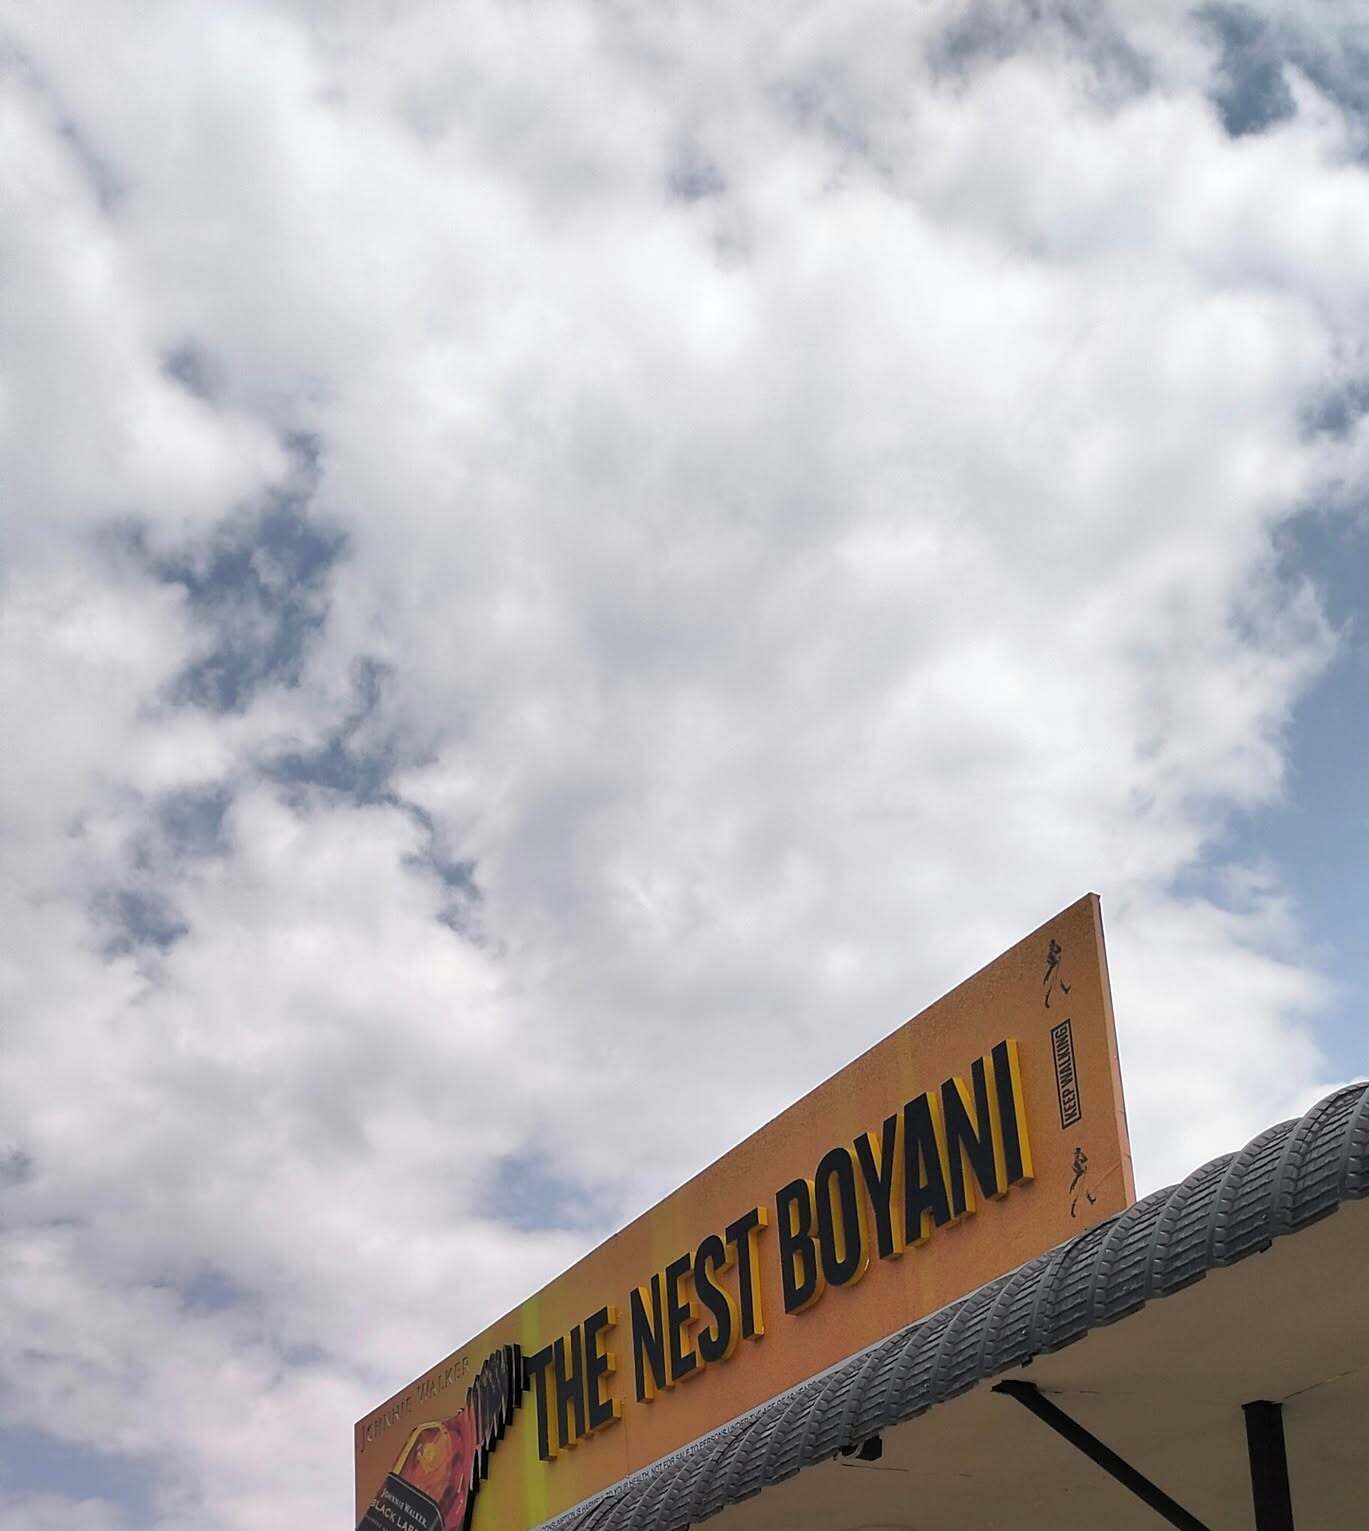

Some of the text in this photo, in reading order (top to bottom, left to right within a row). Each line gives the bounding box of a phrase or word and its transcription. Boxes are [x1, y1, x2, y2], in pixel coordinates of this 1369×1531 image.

[1054, 1024, 1078, 1122] KEEP WALKING
[523, 1039, 1034, 1461] THE NEST BOYANI
